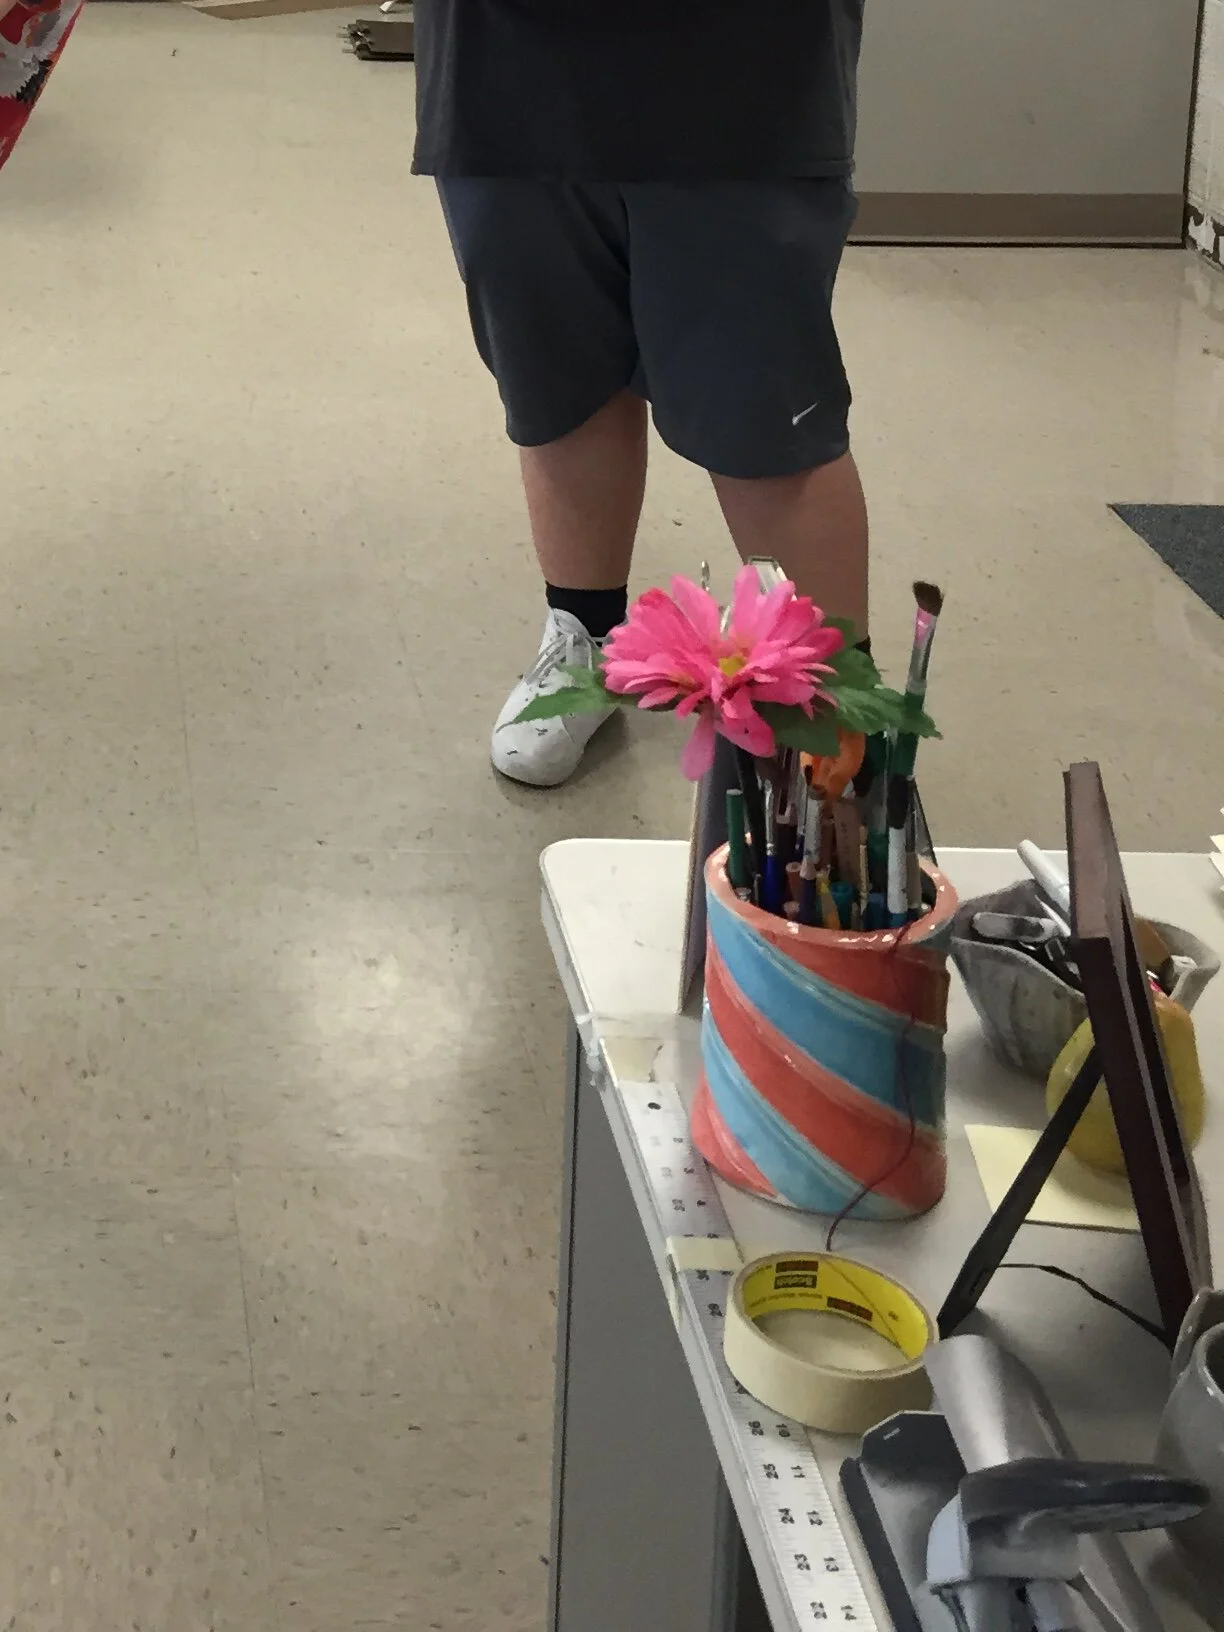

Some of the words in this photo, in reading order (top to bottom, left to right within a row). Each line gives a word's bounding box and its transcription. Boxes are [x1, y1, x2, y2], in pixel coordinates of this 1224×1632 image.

[747, 1420, 764, 1437] 26
[775, 1422, 791, 1438] 10
[763, 1463, 780, 1480] 25
[791, 1464, 806, 1479] 11
[777, 1507, 795, 1524] 24
[806, 1509, 824, 1526] 12
[794, 1553, 812, 1571] 23
[823, 1556, 840, 1573] 13
[840, 1604, 858, 1622] 14
